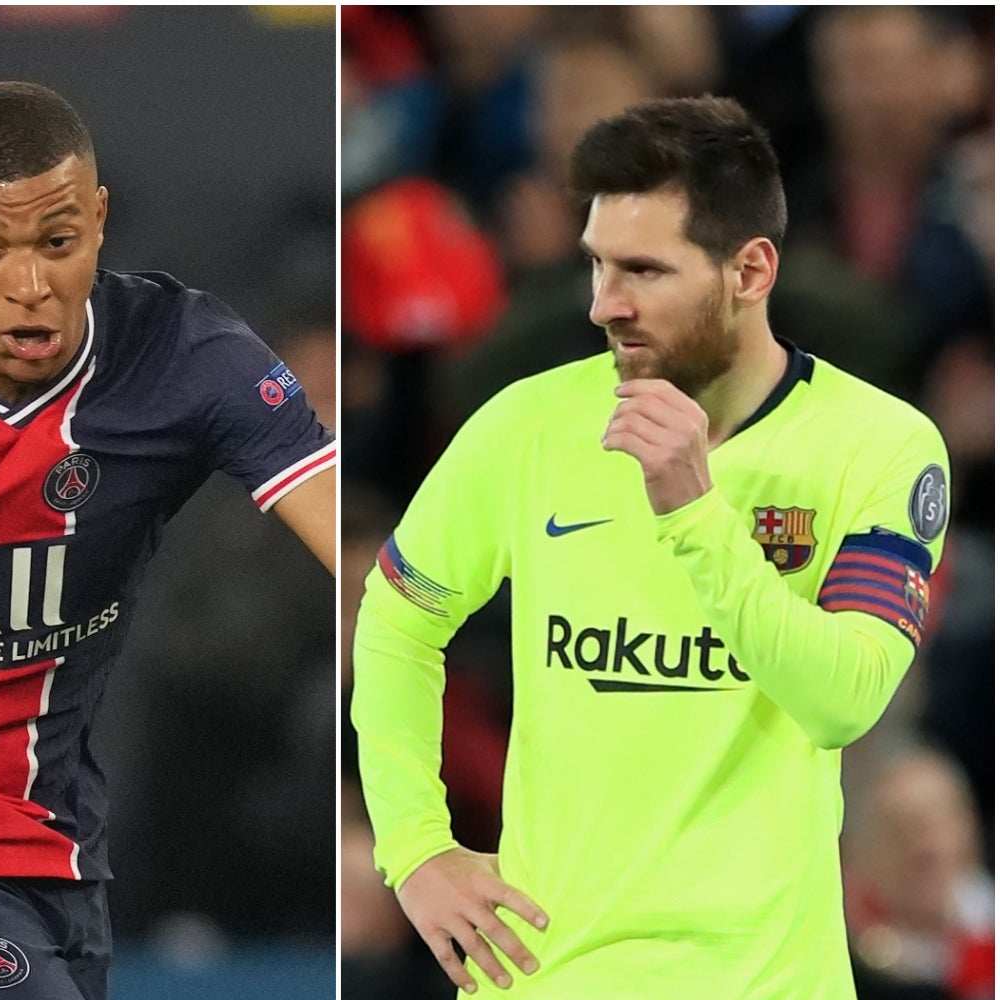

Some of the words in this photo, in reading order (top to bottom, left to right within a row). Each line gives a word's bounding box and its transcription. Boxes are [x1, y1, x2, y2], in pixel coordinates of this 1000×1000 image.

[55, 456, 92, 474] PARIS
[925, 502, 937, 521] 5
[12, 601, 119, 662] LIMITLESS
